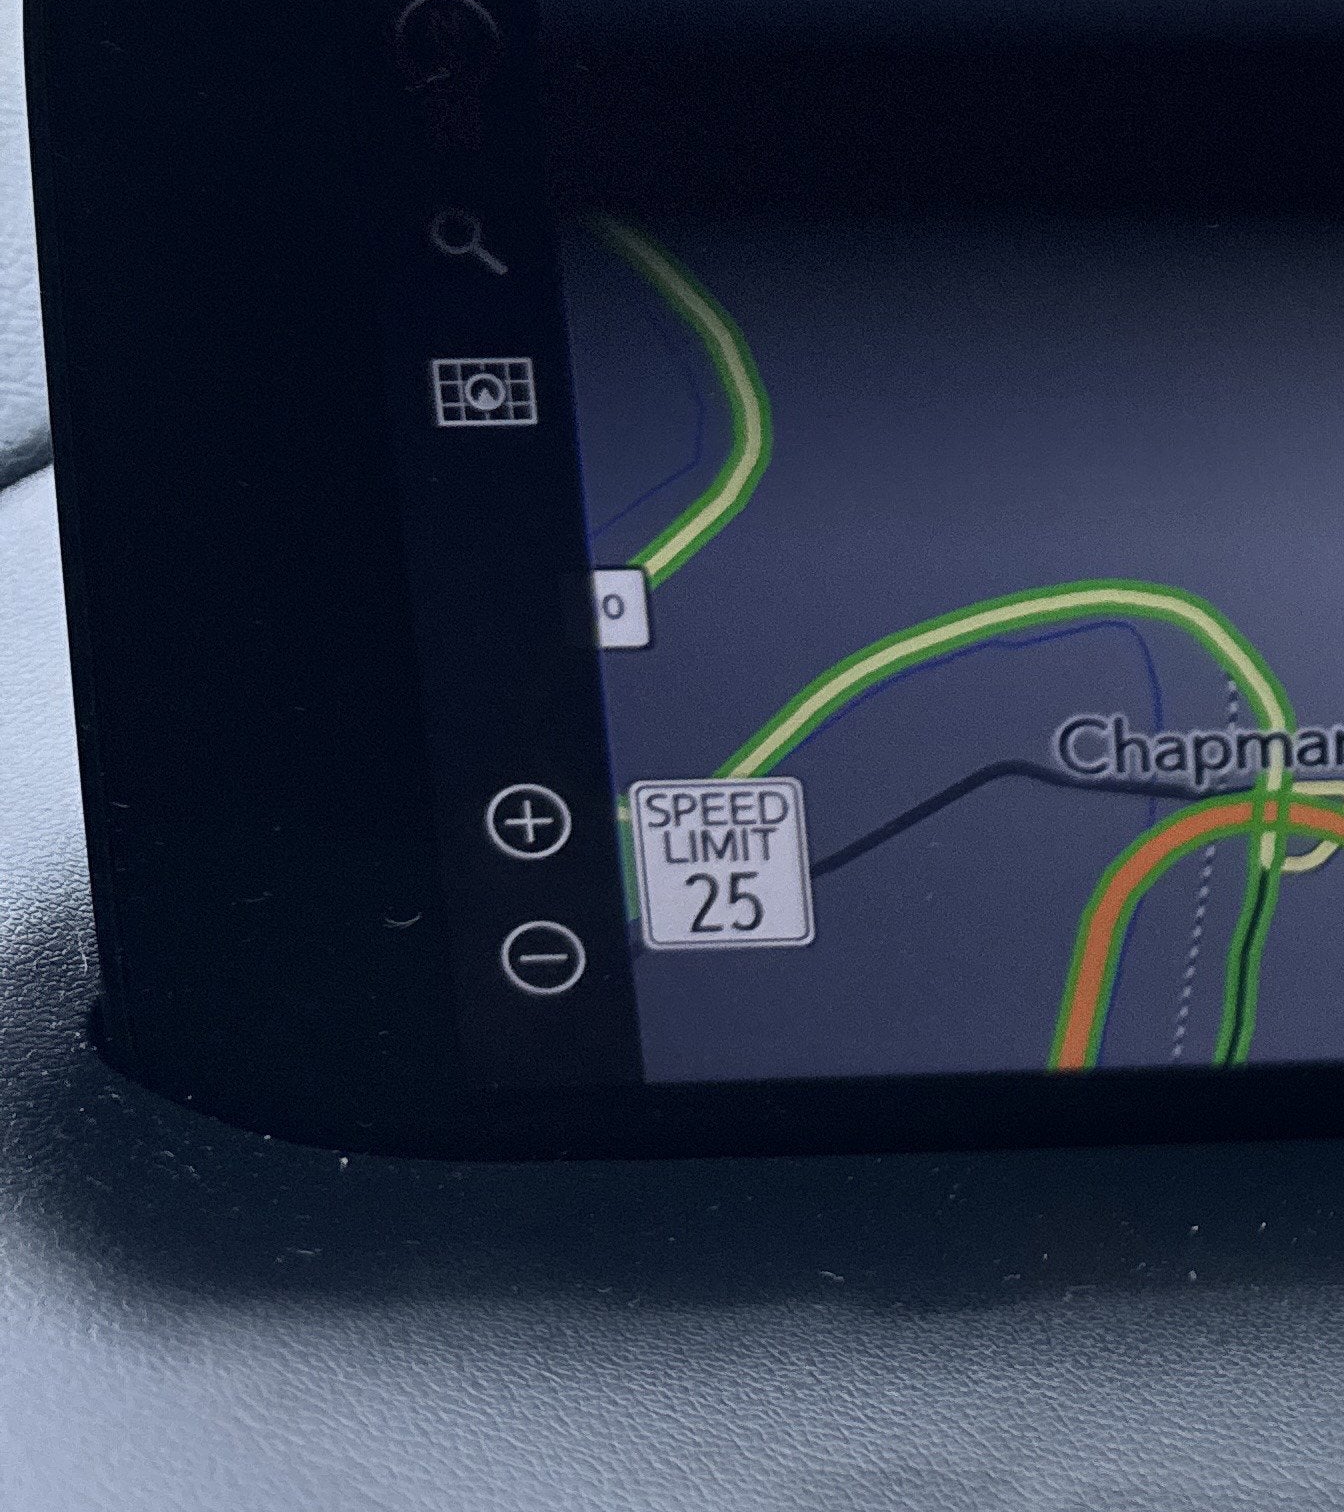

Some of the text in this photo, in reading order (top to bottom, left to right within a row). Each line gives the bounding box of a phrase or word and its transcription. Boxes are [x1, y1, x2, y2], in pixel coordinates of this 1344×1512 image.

[645, 790, 789, 829] SPEED
[664, 826, 778, 864] LIMIT
[685, 872, 765, 934] 25
